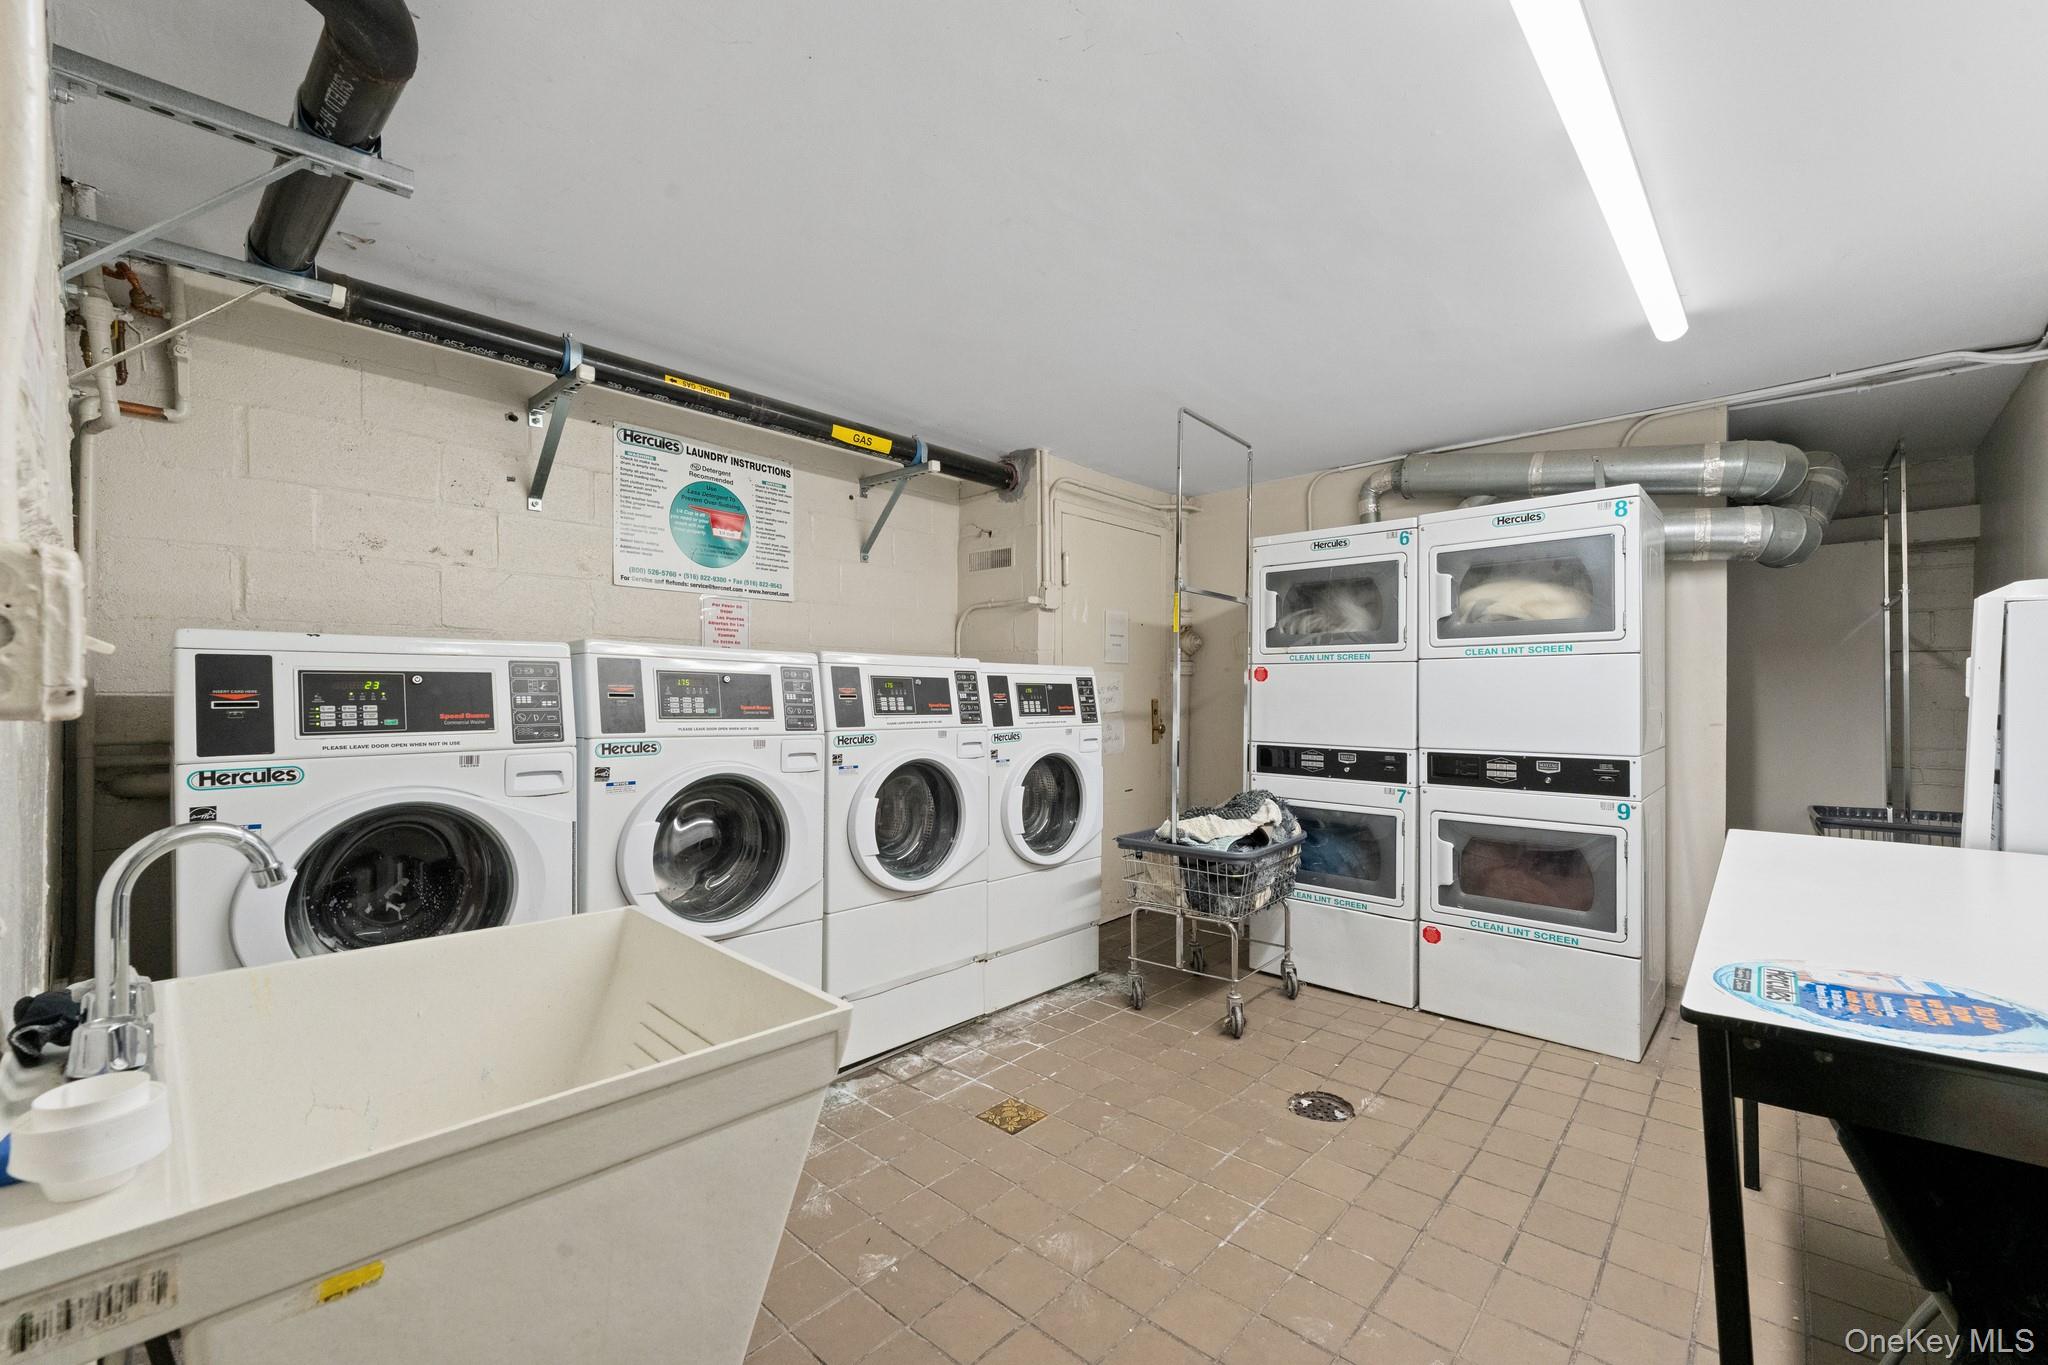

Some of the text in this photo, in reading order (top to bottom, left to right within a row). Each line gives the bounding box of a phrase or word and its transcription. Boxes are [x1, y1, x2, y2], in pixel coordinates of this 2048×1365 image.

[408, 330, 438, 343] ASTM
[443, 339, 497, 358] A53/ASME
[682, 381, 726, 398] NATURAL GAS
[853, 434, 873, 446] GAS
[623, 429, 791, 478] Hercules LAUNDRY INSTRUCTIONS
[689, 471, 734, 486] Recommended
[702, 466, 731, 477] Detergent
[702, 491, 729, 501] Detergent
[1614, 500, 1628, 518] 8
[1497, 512, 1542, 526] Hercules
[1313, 539, 1347, 550] Hercules
[1400, 531, 1410, 545] 6
[748, 588, 790, 597] www.hercnet.com
[1337, 653, 1371, 661] SCREEN
[1464, 645, 1573, 656] CLEAN LINT SCREEN
[364, 681, 380, 690] 23
[837, 734, 874, 745] Hercules
[993, 732, 1020, 742] Hercules
[601, 742, 657, 755] Hercules
[199, 768, 297, 787] Hercules
[1397, 789, 1407, 803] 7
[1617, 803, 1631, 820] 9
[1314, 895, 1331, 904] LINT
[1333, 898, 1368, 910] SCREEN
[1470, 920, 1579, 946] CLEAN LINT SCREEN
[1766, 968, 1797, 1002] Hercules
